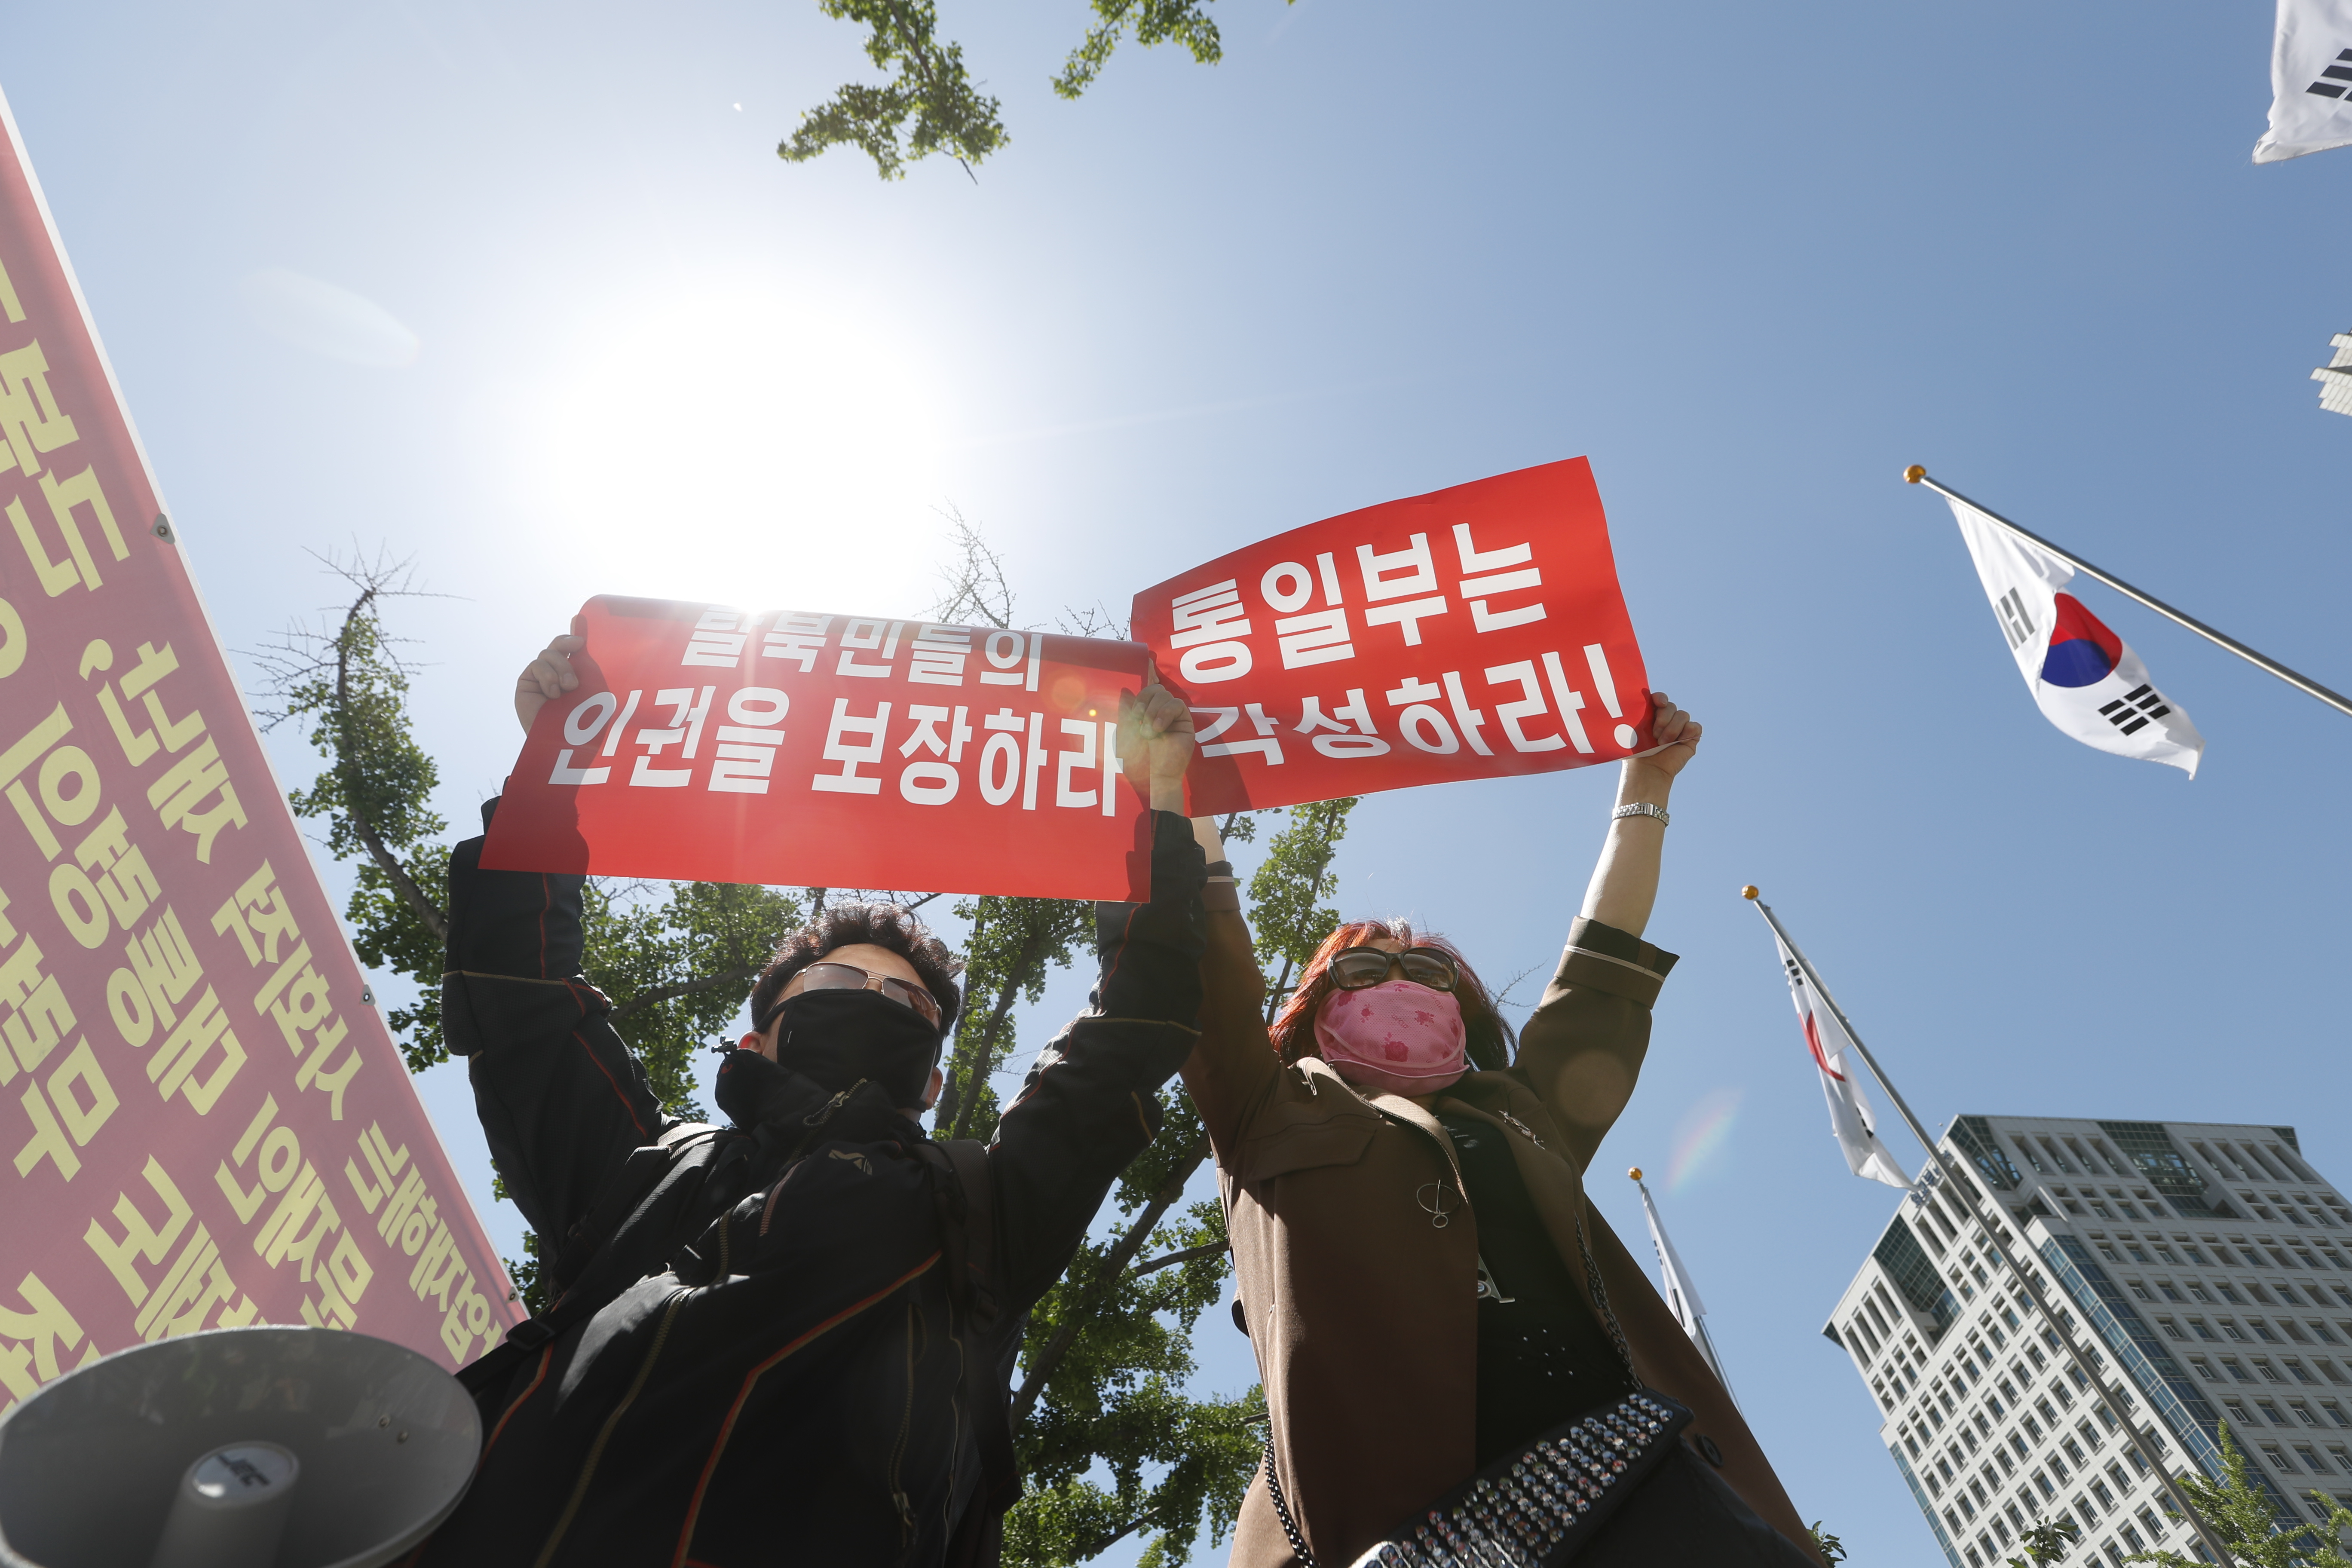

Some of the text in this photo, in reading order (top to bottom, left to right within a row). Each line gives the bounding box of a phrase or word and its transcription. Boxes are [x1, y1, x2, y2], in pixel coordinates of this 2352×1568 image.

[681, 605, 1043, 692] 탈북민들의
[1170, 523, 1547, 684] 통일부는
[548, 686, 1124, 817] 인권을 보장하라
[1188, 643, 1638, 766] 각성하라!
